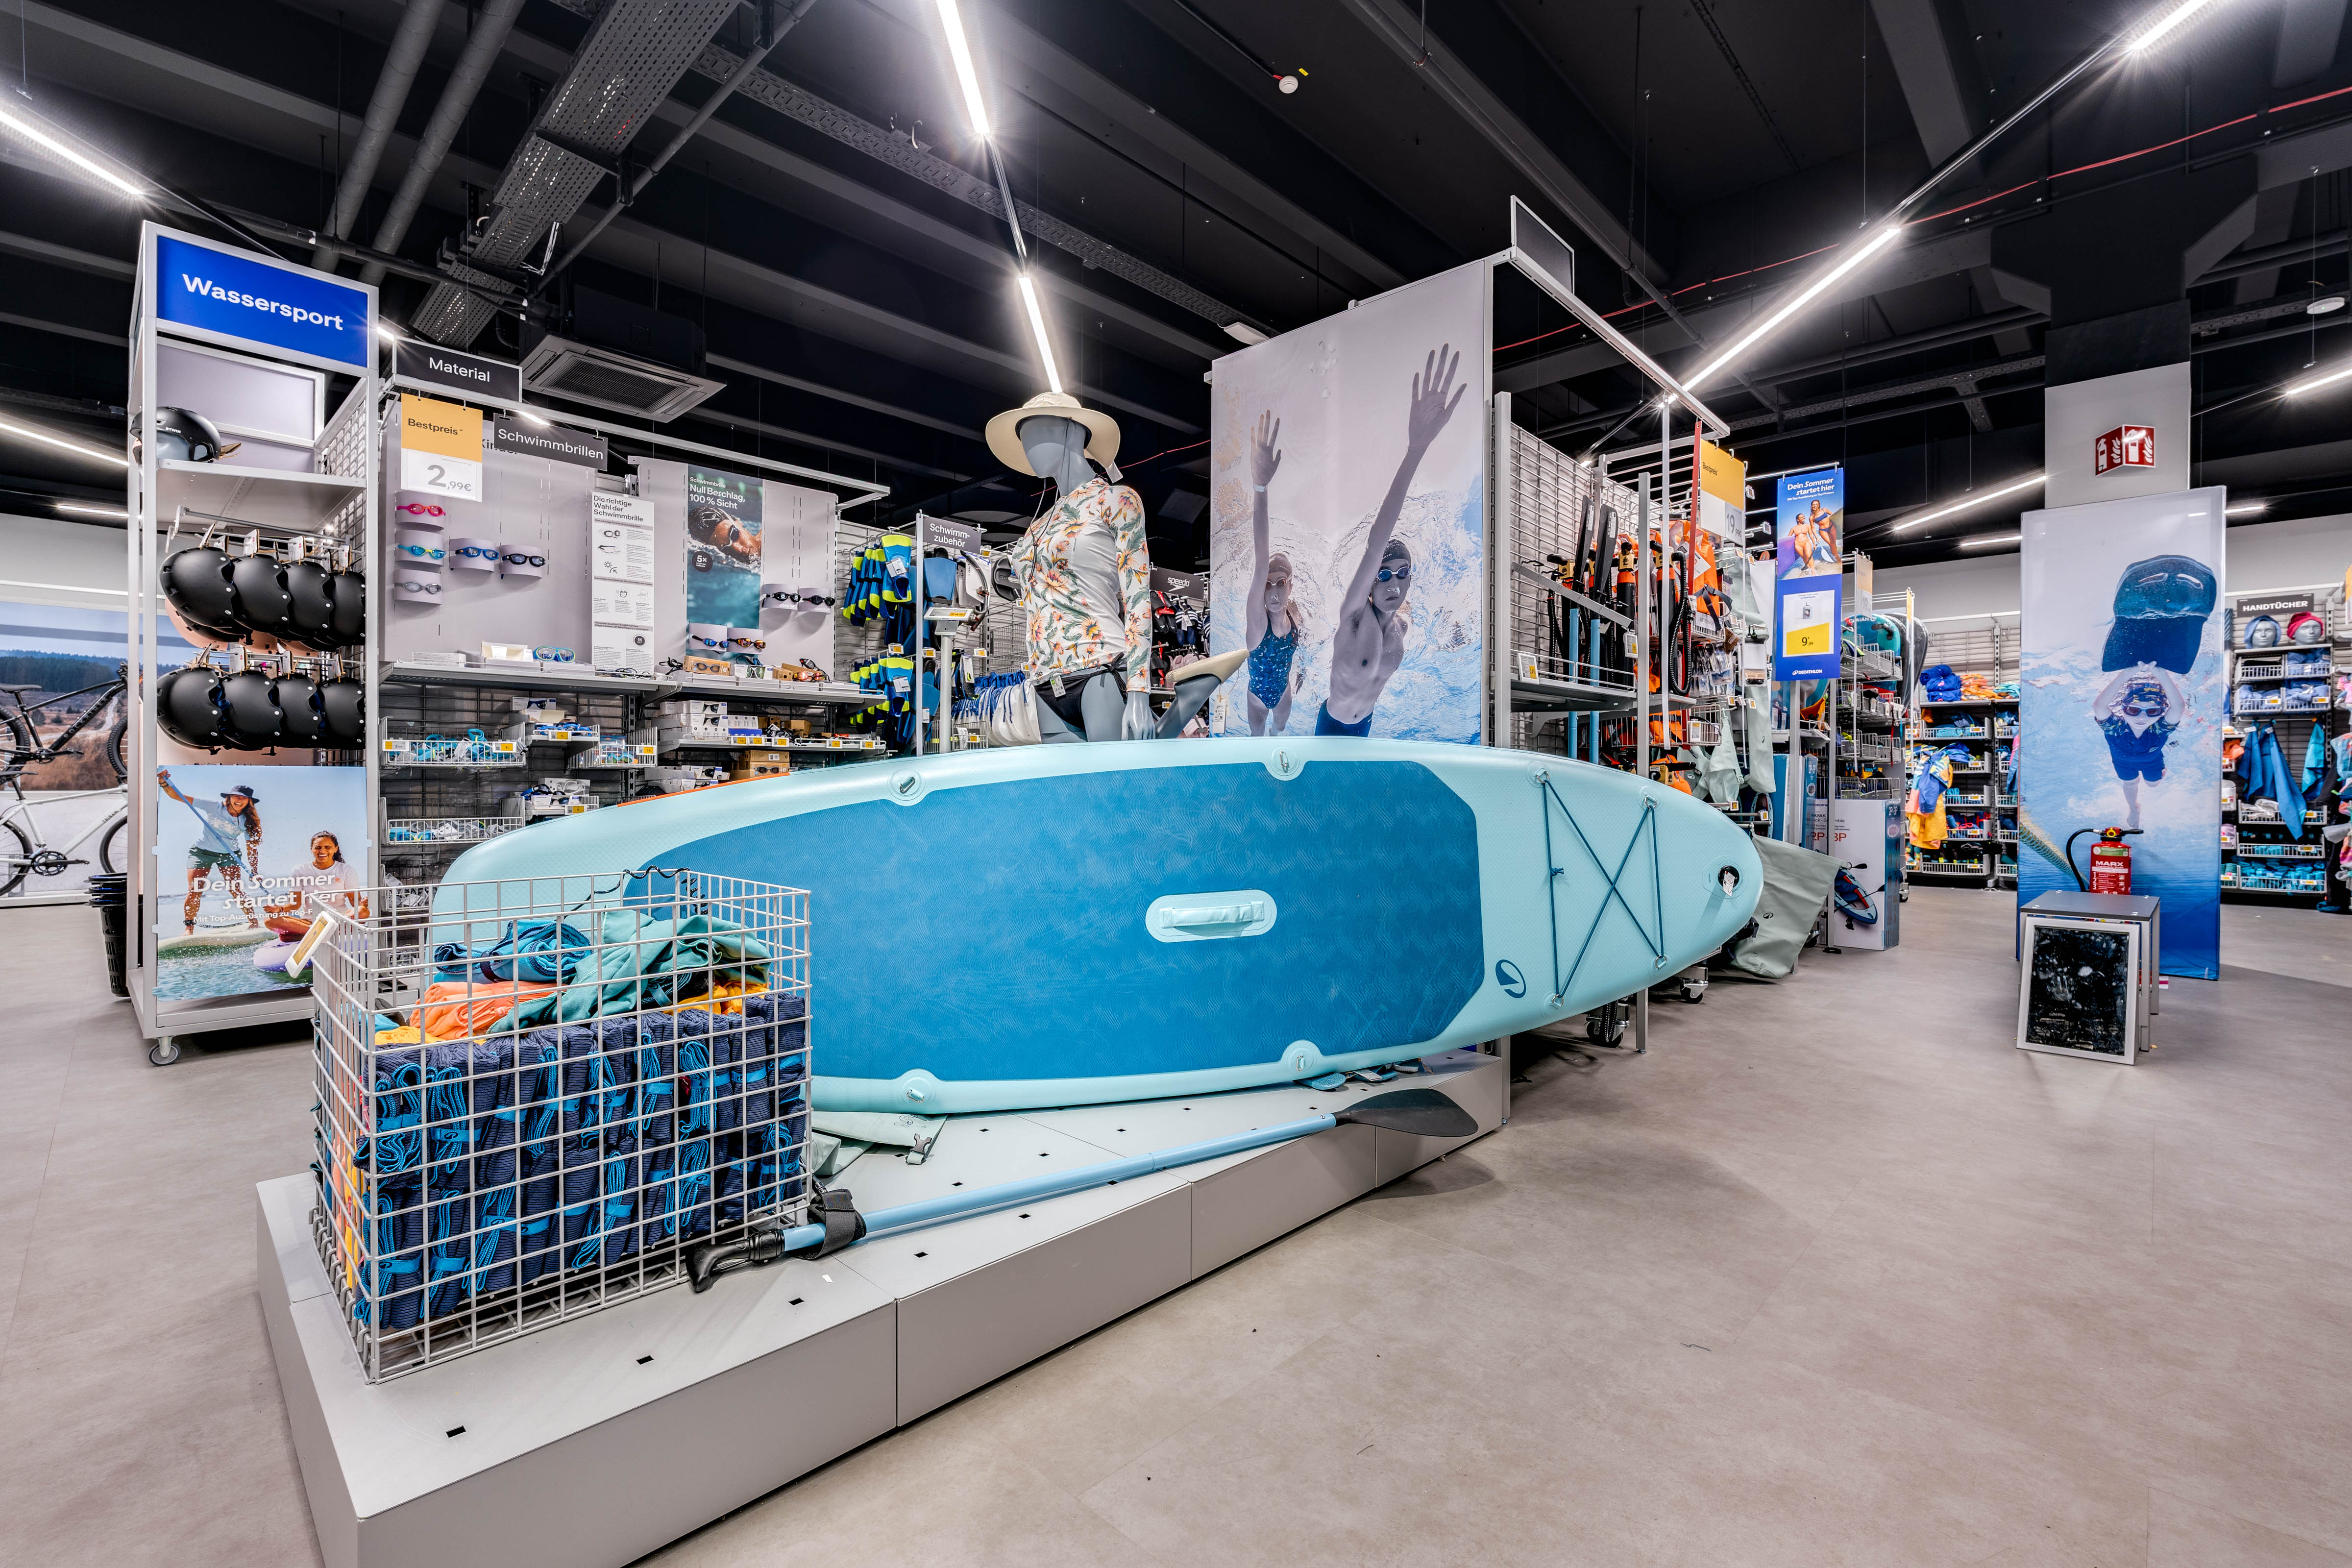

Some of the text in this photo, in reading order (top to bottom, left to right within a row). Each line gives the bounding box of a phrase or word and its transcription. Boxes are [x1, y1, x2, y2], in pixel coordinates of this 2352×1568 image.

[182, 274, 344, 331] Wassersport
[429, 357, 490, 383] Material
[408, 418, 458, 436] Bestpreis
[498, 428, 604, 460] Schwimmbrillen
[1702, 462, 1717, 476] Bestpreis
[690, 477, 726, 489] Schwimmbrille
[1804, 478, 1834, 488] Sommer
[690, 484, 746, 503] Null Beschlag,
[1796, 487, 1820, 495] startet
[606, 498, 632, 507] richtige
[689, 493, 738, 510] 100 % Sicht
[593, 509, 643, 522] Schwimmbrille
[930, 523, 970, 539] Schwimm-
[934, 534, 965, 547] zubehör
[1167, 577, 1190, 587] speedo
[2243, 601, 2308, 612] HANDTÜCHER
[63, 697, 108, 738] ROCKRIDER
[194, 874, 335, 893] Dein Sommer
[222, 890, 338, 910] startet her
[209, 911, 279, 923] Top-Ausrüstung
